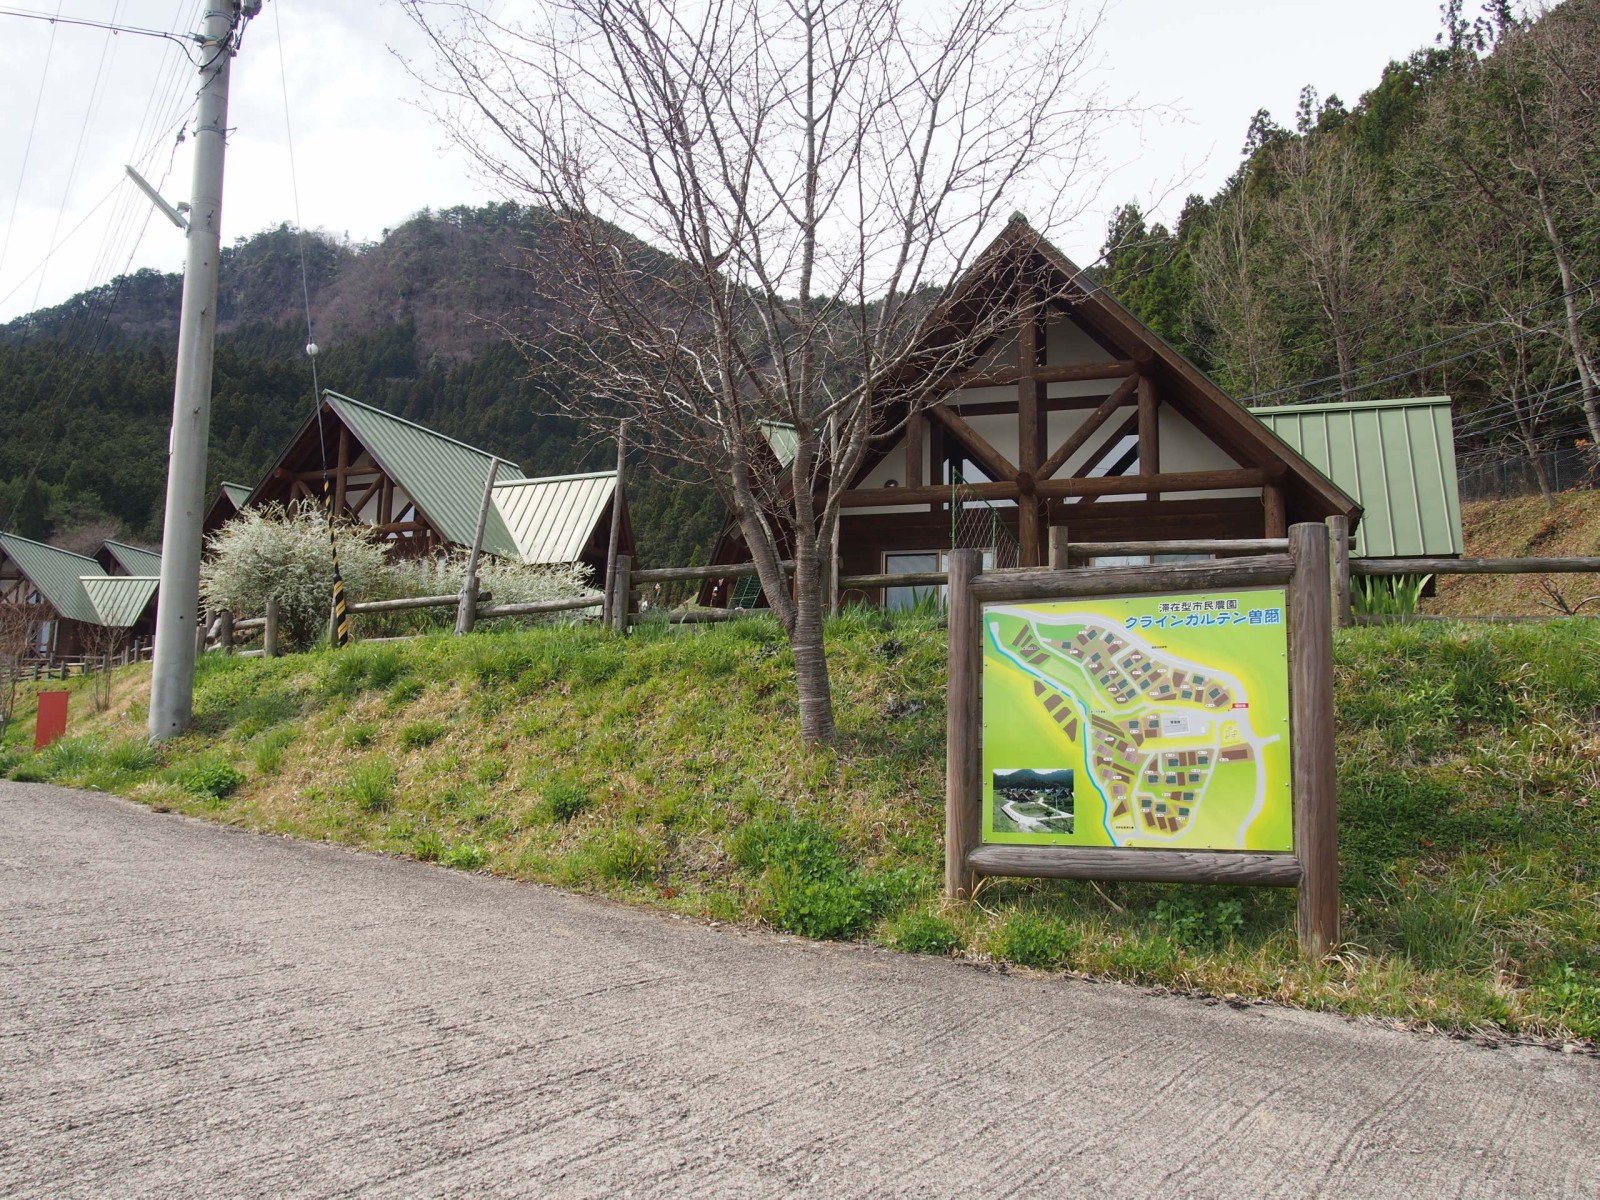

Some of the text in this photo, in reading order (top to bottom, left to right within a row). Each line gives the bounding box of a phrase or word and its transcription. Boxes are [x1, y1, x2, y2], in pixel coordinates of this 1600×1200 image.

[1159, 600, 1237, 612] 滞在型市民農園
[1125, 609, 1280, 629] クラインガルテン曽爾
